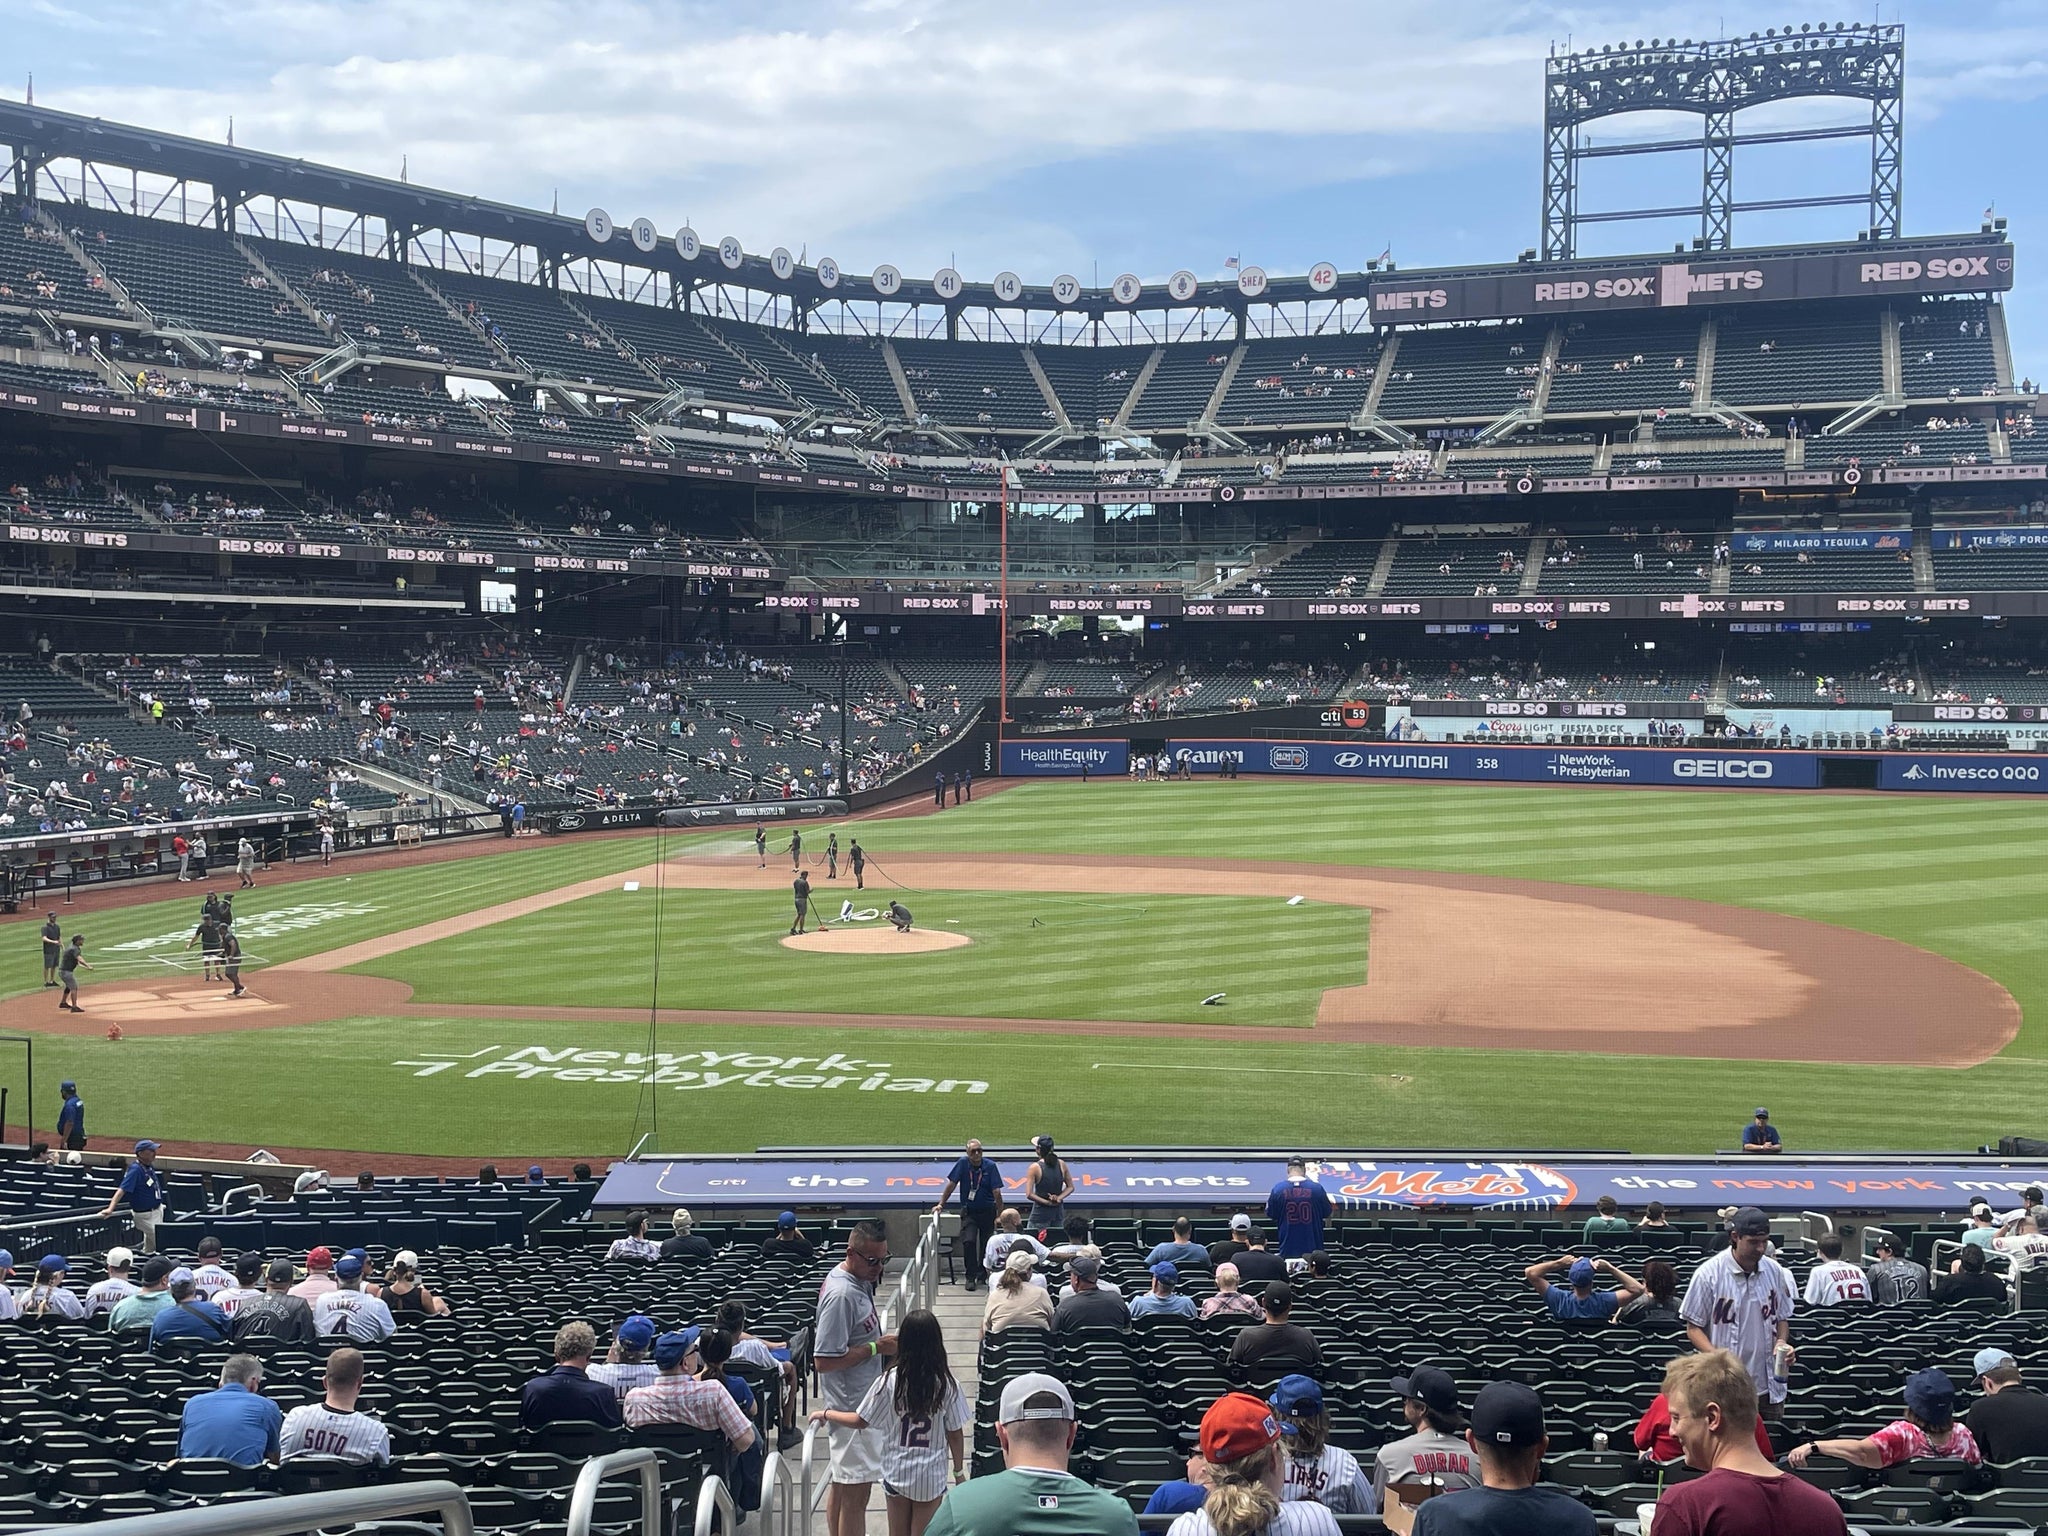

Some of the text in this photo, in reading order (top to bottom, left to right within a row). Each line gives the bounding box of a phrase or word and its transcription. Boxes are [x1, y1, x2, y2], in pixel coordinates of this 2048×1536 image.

[596, 218, 603, 233] 5
[639, 227, 650, 242] 18
[682, 236, 694, 252] 16
[724, 246, 738, 260] 24
[778, 256, 788, 269] 17
[1861, 256, 1989, 282] RED SOX
[822, 266, 834, 280] 36
[881, 273, 893, 286] 31
[1314, 270, 1331, 284] 42
[942, 277, 954, 290] 41
[1002, 280, 1014, 293] 14
[1242, 276, 1263, 288] SHEA
[1536, 271, 1764, 302] RED SOX METS
[1058, 283, 1074, 296] 37
[1377, 290, 1446, 310] METS
[15, 395, 37, 404] METS
[62, 402, 136, 416] RED SOX METS
[282, 424, 348, 438] RED SOX METS
[372, 434, 432, 446] RED SOX METS
[456, 442, 512, 454] RED SOX METS
[548, 451, 600, 462] RED SOX METS
[10, 526, 127, 548] RED SOX METS
[1774, 540, 1820, 548] MILAGRO
[1824, 538, 1868, 546] TEQUILA
[1972, 536, 1993, 545] THE
[220, 539, 341, 558] RED SOX METS
[387, 548, 494, 566] RED SOX METS
[534, 556, 628, 572] RED SOX METS
[688, 564, 770, 579] RED SOX METS
[780, 597, 808, 607] SOX
[822, 598, 860, 608] METS
[904, 598, 930, 609] RED
[932, 598, 959, 610] SOX
[1050, 600, 1152, 610] RED SOX METS
[1308, 604, 1420, 614] RED SOX METS
[1492, 602, 1610, 614] RED SOX METS
[1741, 600, 1785, 611] METS
[1838, 599, 1970, 610] RED SOX METS
[1188, 605, 1214, 616] SOX
[1228, 605, 1265, 616] METS
[1320, 710, 1341, 722] citi
[1352, 708, 1366, 719] 59
[1486, 703, 1520, 715] RED
[1578, 704, 1626, 716] METS
[1934, 706, 1975, 719] RED
[1490, 718, 1624, 733] Coors LIGHT FIESTA DECK
[1176, 748, 1244, 764] Canon
[1368, 754, 1448, 770] HYUNDAI
[1560, 754, 1614, 766] NewYork-
[1476, 758, 1498, 769] 358
[1674, 759, 1772, 778] GEICO
[1560, 766, 1630, 780] Presbyterian
[1932, 764, 2040, 780] Invesco QQQ
[559, 816, 580, 828] Ford
[612, 813, 640, 823] DELTA
[503, 1046, 891, 1070] NewYork-
[464, 1061, 990, 1094] Presbyterian
[708, 1174, 1250, 1189] citi the ne yk mets
[1340, 1170, 1529, 1196] Mets
[1611, 1176, 1698, 1189] the
[1711, 1178, 1816, 1191] new
[1827, 1177, 1946, 1193] york
[1286, 1202, 1312, 1224] 20
[1830, 1270, 1862, 1282] DURAN
[1892, 1276, 1919, 1301] 12
[327, 1300, 362, 1314] ALVAREZ
[254, 1315, 271, 1336] 4
[330, 1314, 348, 1334] 4
[900, 1414, 932, 1448] 12
[304, 1428, 348, 1456] SOTO
[1413, 1452, 1470, 1476] DURAN
